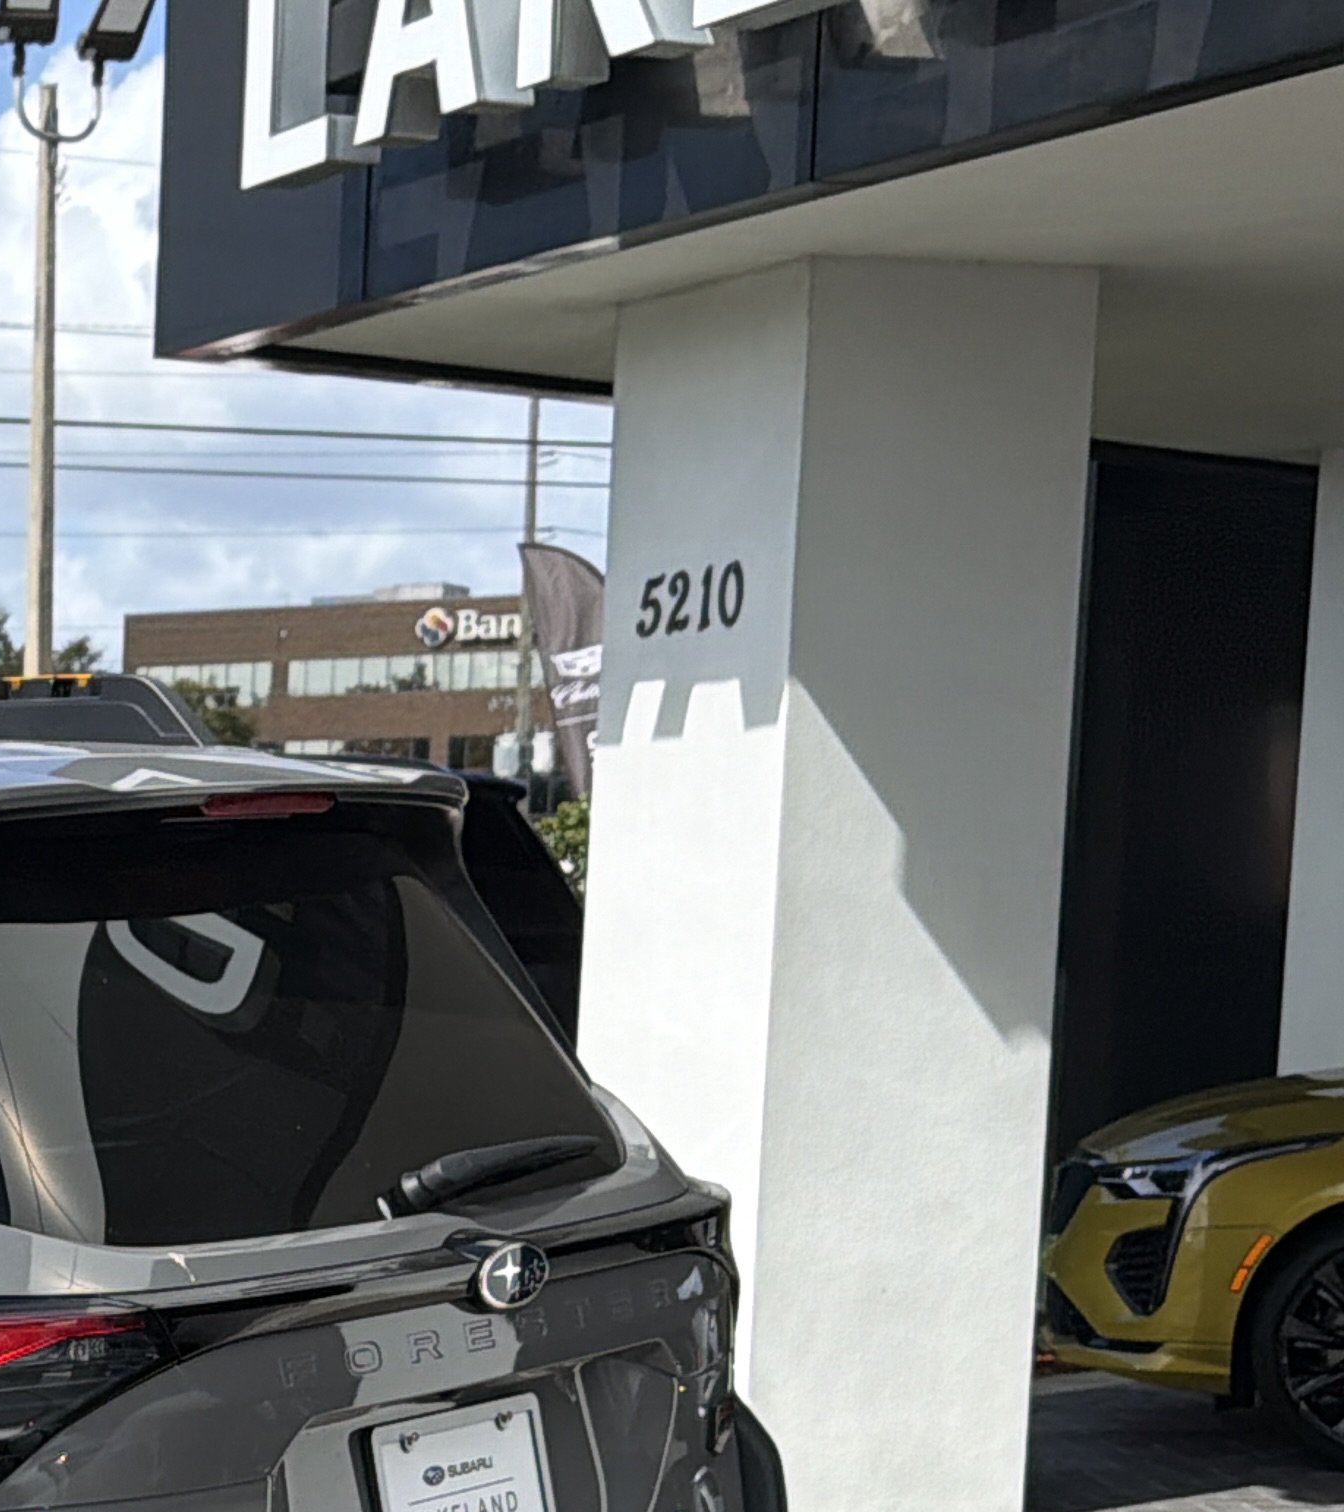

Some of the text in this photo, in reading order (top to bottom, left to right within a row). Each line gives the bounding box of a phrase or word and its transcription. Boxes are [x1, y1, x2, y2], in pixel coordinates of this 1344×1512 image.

[454, 608, 523, 641] Ban
[636, 559, 744, 638] 5210
[279, 1279, 674, 1388] FORESTER
[447, 1456, 494, 1478] SUBARU
